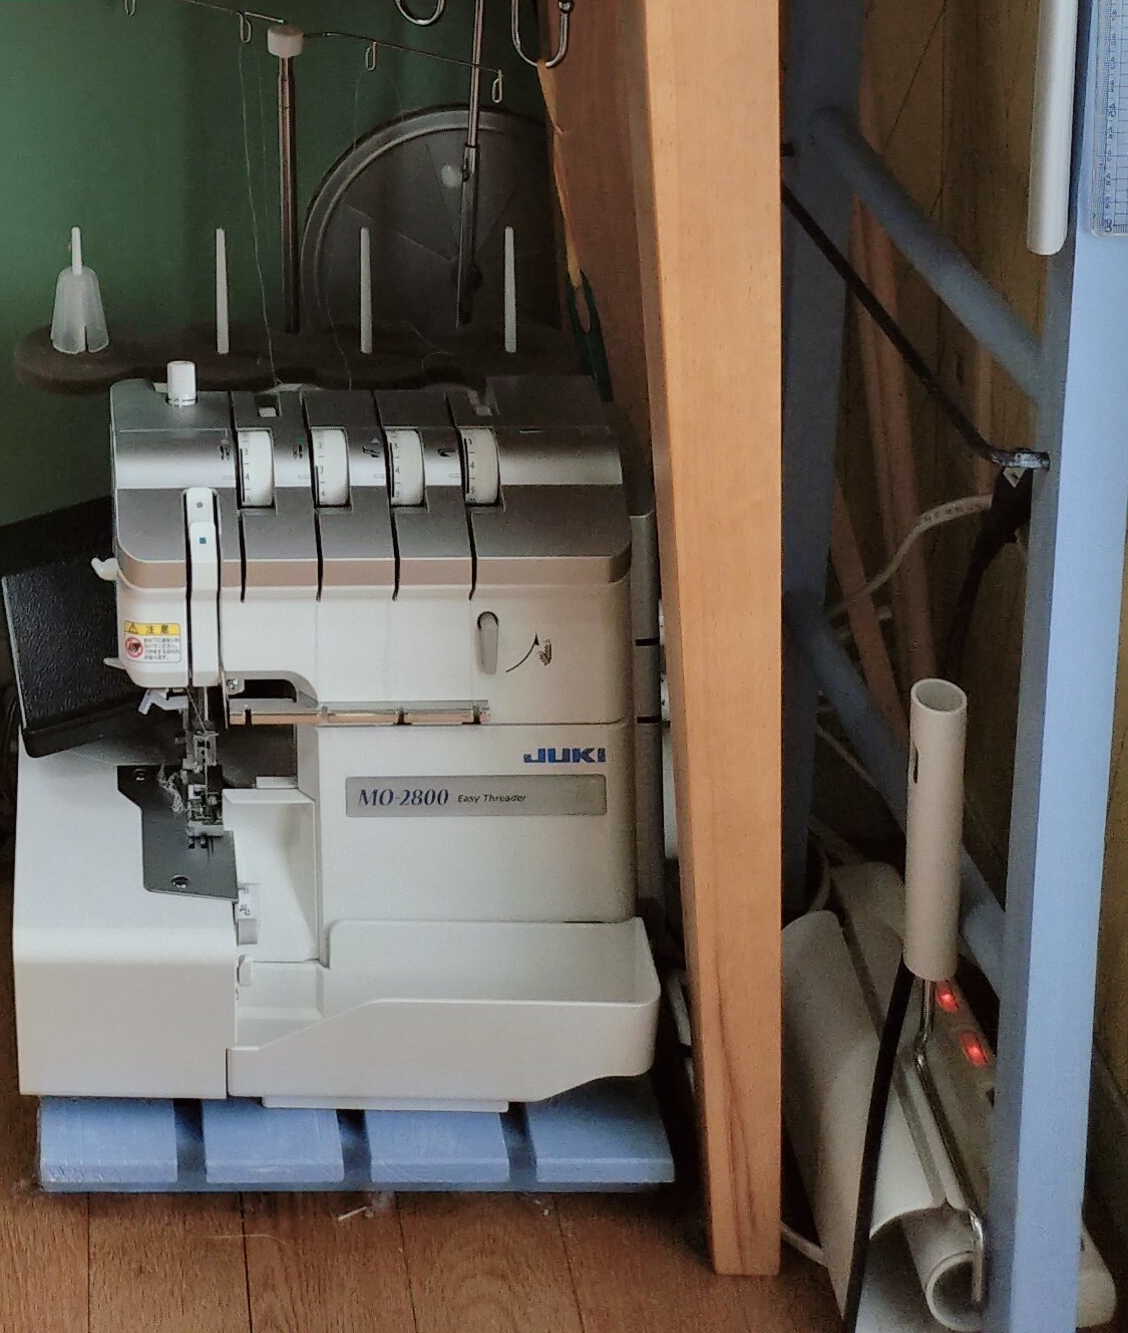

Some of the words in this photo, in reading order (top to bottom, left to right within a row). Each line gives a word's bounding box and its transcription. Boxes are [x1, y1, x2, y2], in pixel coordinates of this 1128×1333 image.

[523, 747, 606, 763] JUKI
[359, 789, 449, 807] MO-2800
[457, 794, 480, 804] Easy
